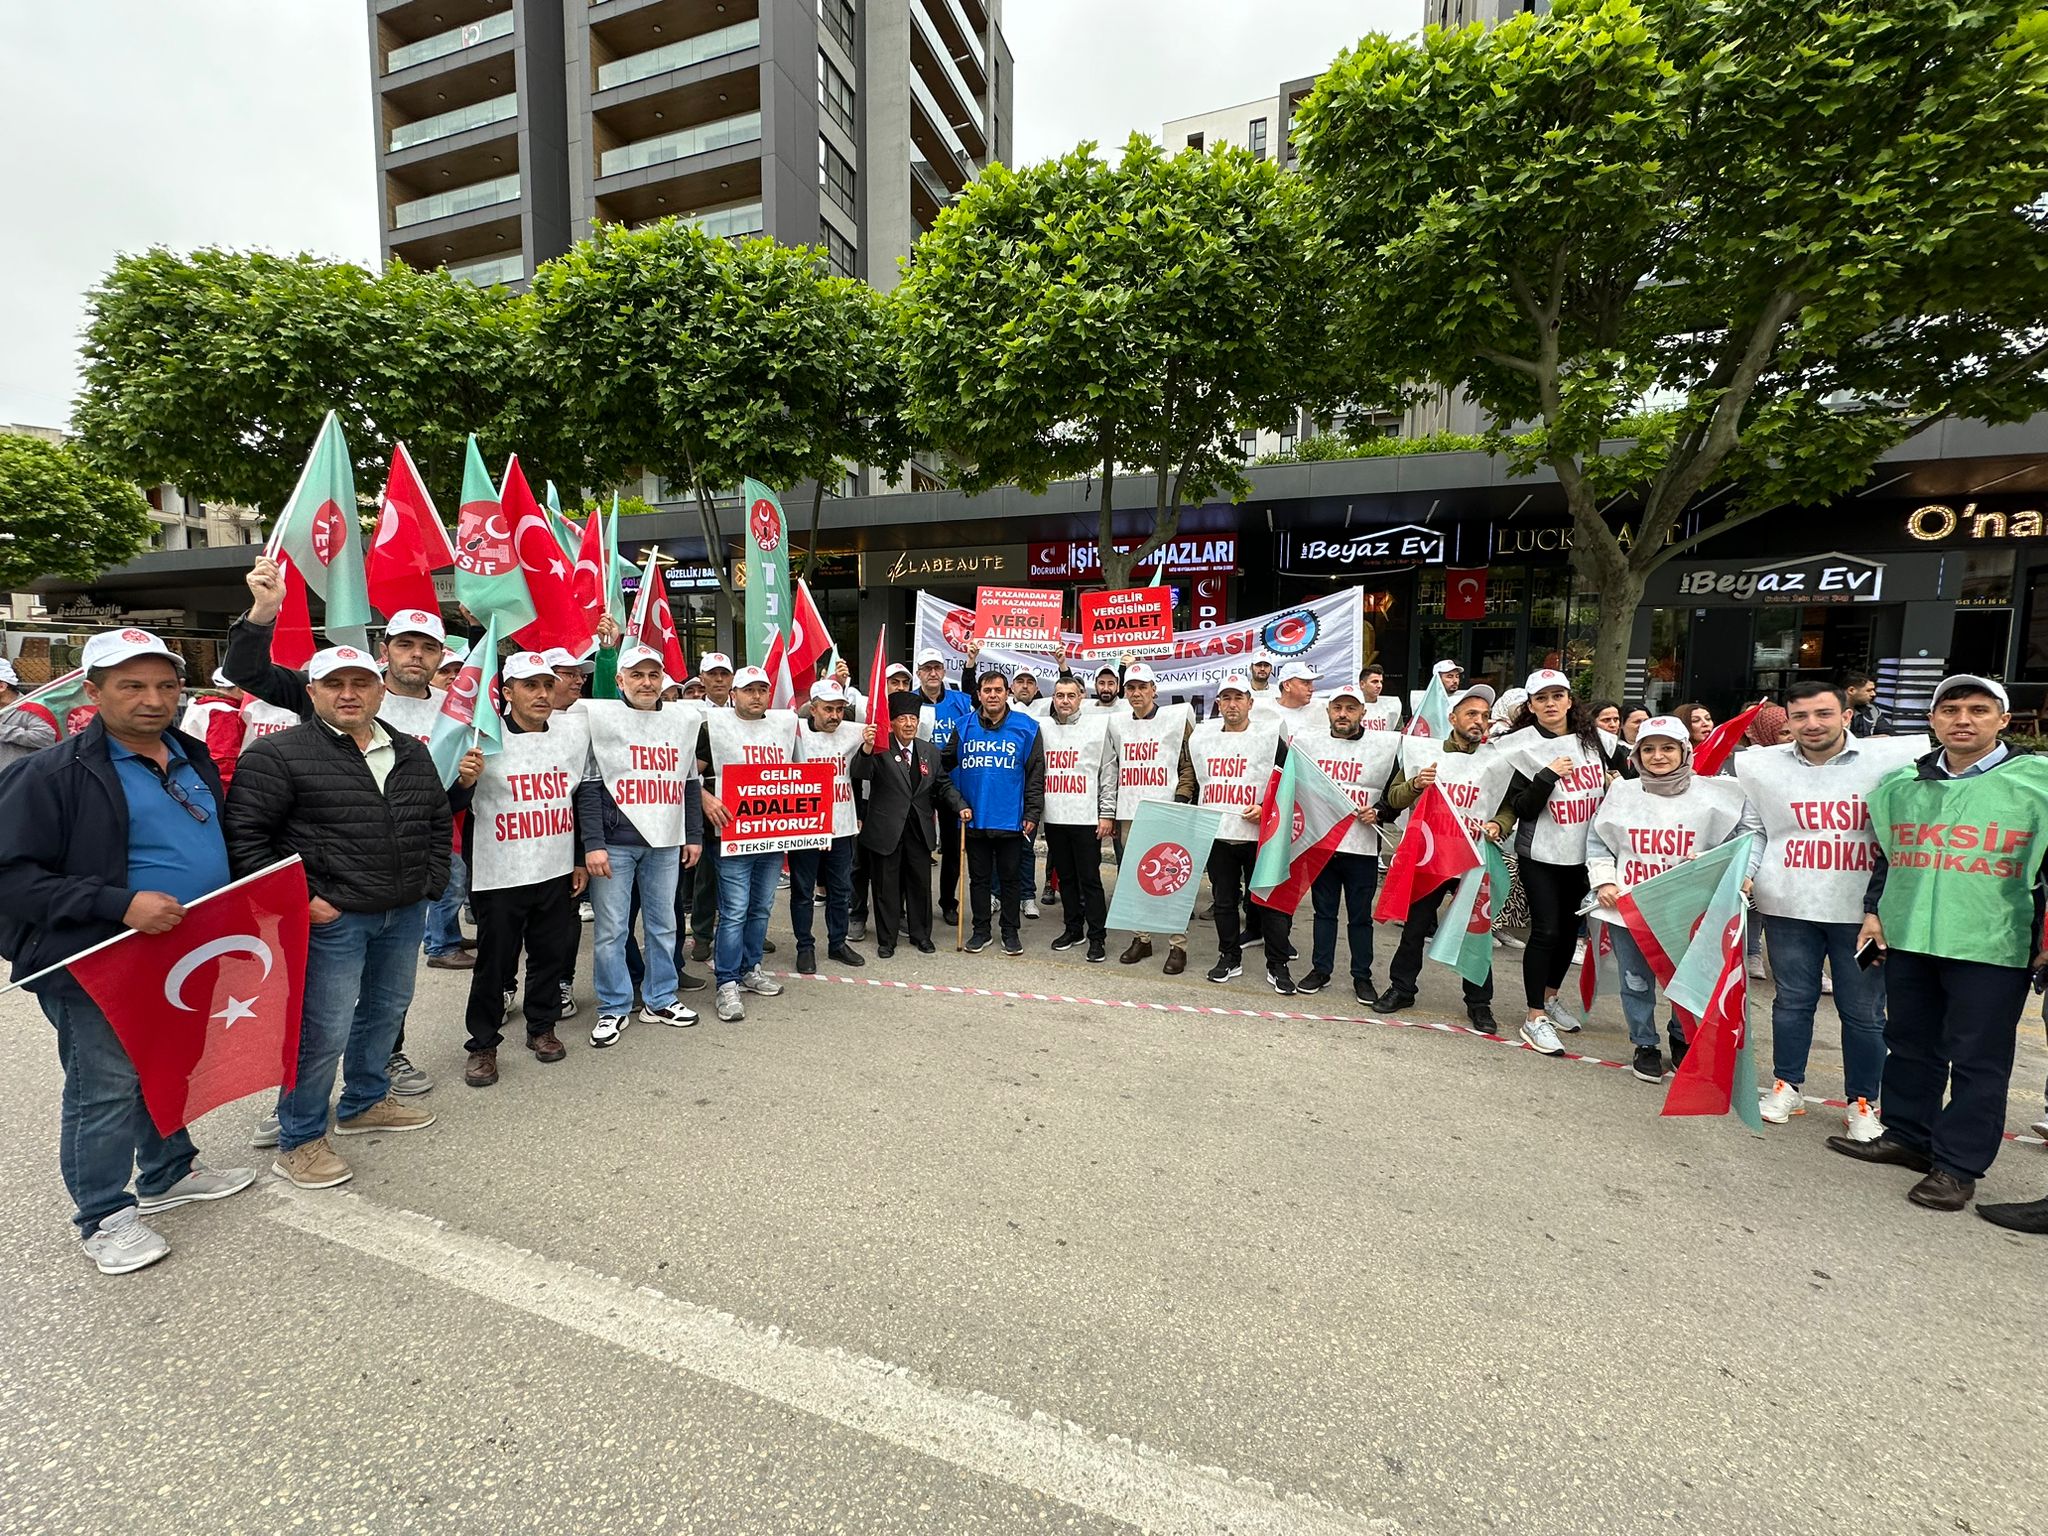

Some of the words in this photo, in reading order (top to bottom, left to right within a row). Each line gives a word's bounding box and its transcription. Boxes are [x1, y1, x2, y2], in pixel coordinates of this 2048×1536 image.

[1906, 502, 2048, 540] O'na
[1308, 541, 1390, 563] Beyaz
[1401, 537, 1438, 555] Ev
[1498, 528, 1575, 554] LUCK
[1690, 570, 1806, 600] Beyaz
[1818, 567, 1872, 591] Ev
[1092, 602, 1161, 617] VERGİSİNDE
[1109, 592, 1143, 604] GELİR
[991, 614, 1045, 628] VERGİ
[1092, 613, 1162, 632] ADALET
[1155, 669, 1198, 683] SANAYİ
[630, 742, 679, 772] TEKSİF
[963, 739, 1016, 755] TÜRK-İŞ
[1046, 747, 1079, 769] TEKSİF
[1123, 738, 1159, 761] TEKSİF
[760, 767, 802, 781] GELİR
[961, 755, 1016, 770] GÖREVLİ
[1207, 753, 1247, 777] TEKSİF
[507, 766, 569, 802] TEKSİF
[1044, 771, 1087, 794] ENDİKASI
[1119, 763, 1168, 787] ENDİKASI
[737, 781, 822, 797] VERGİSİNDE
[736, 797, 821, 817] ADALET
[495, 803, 574, 842] SENDİKAS
[735, 812, 826, 835] İSTİYORUZ!
[740, 839, 775, 853] TEKSİF
[777, 837, 828, 849] SENDİKASI
[1628, 824, 1696, 857] TEKSİF
[1784, 834, 1881, 872] SENDİKAS
